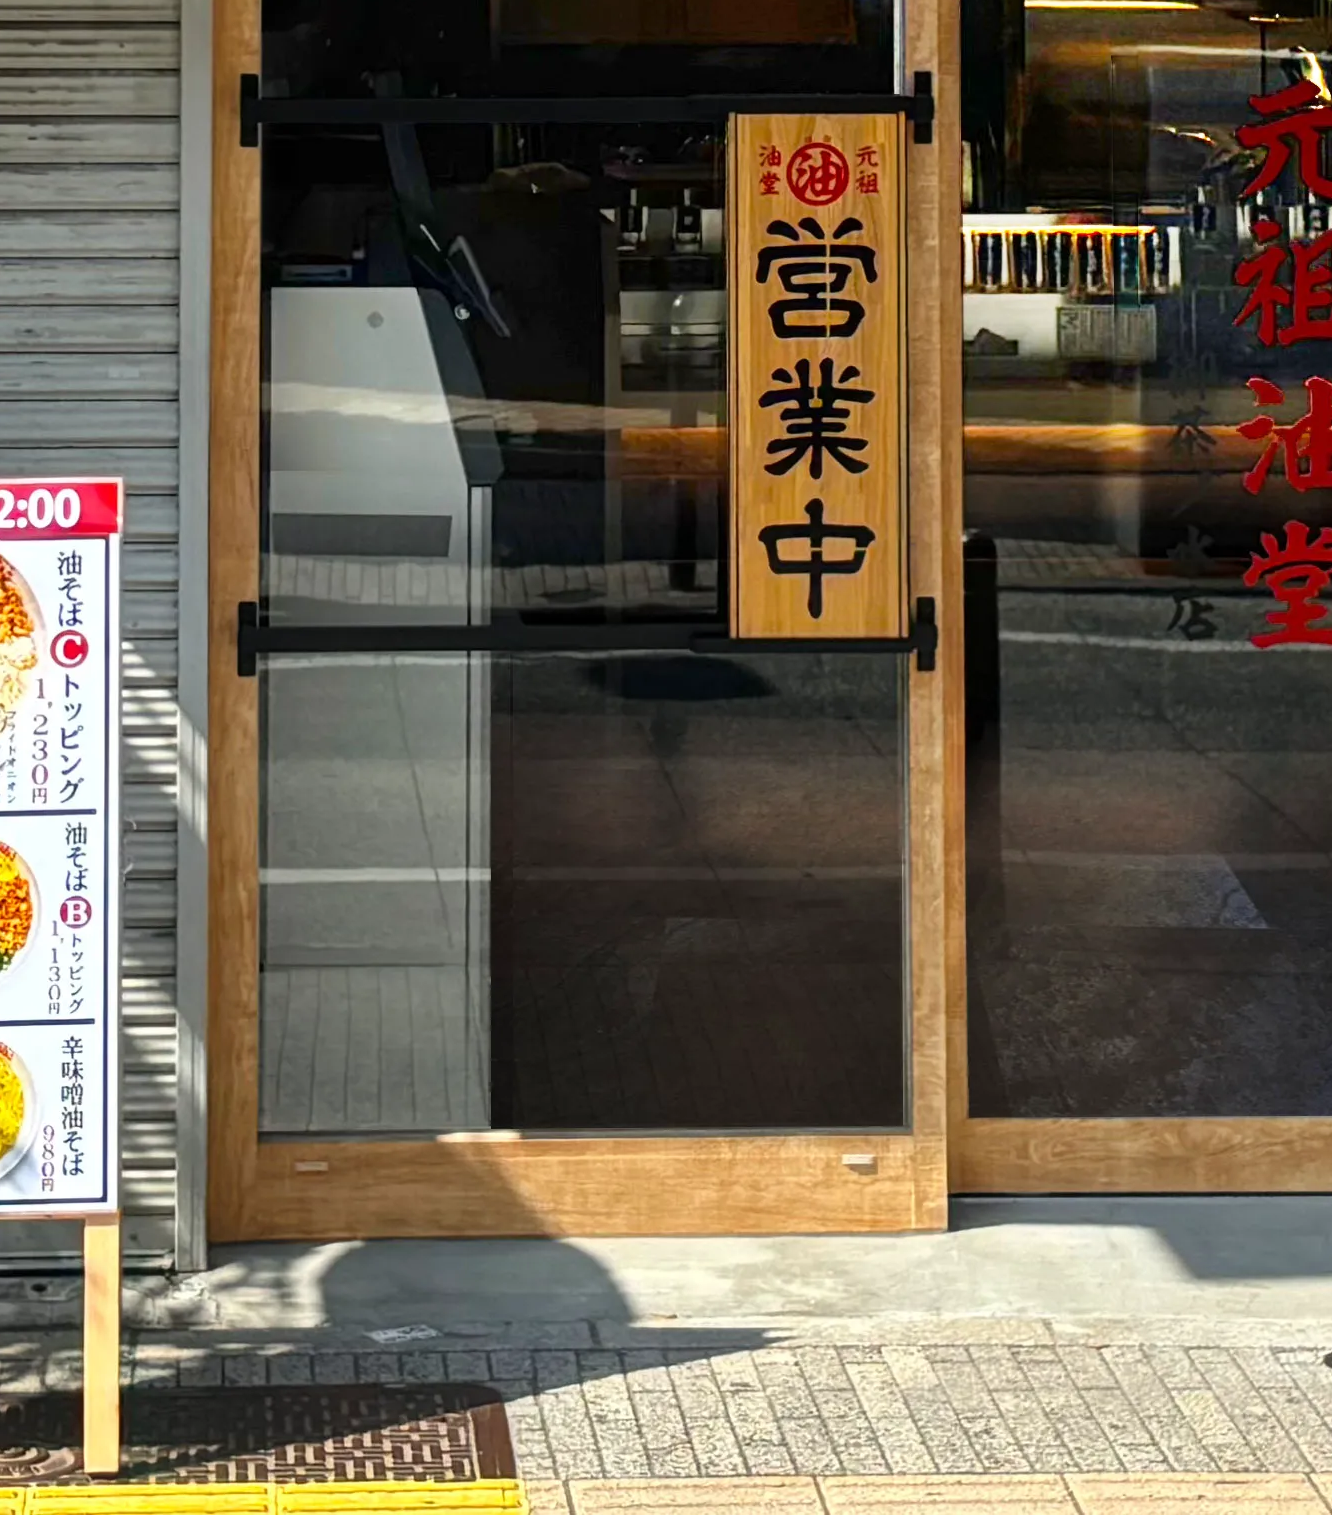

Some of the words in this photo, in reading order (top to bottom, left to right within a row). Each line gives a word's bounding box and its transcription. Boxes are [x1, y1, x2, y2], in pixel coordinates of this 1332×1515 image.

[755, 216, 878, 619] 営業中
[31, 678, 53, 804] 1,230円
[48, 920, 64, 1015] 1,130円
[41, 1124, 55, 1193] 980円
[61, 1035, 84, 1177] 辛味噌油そば
